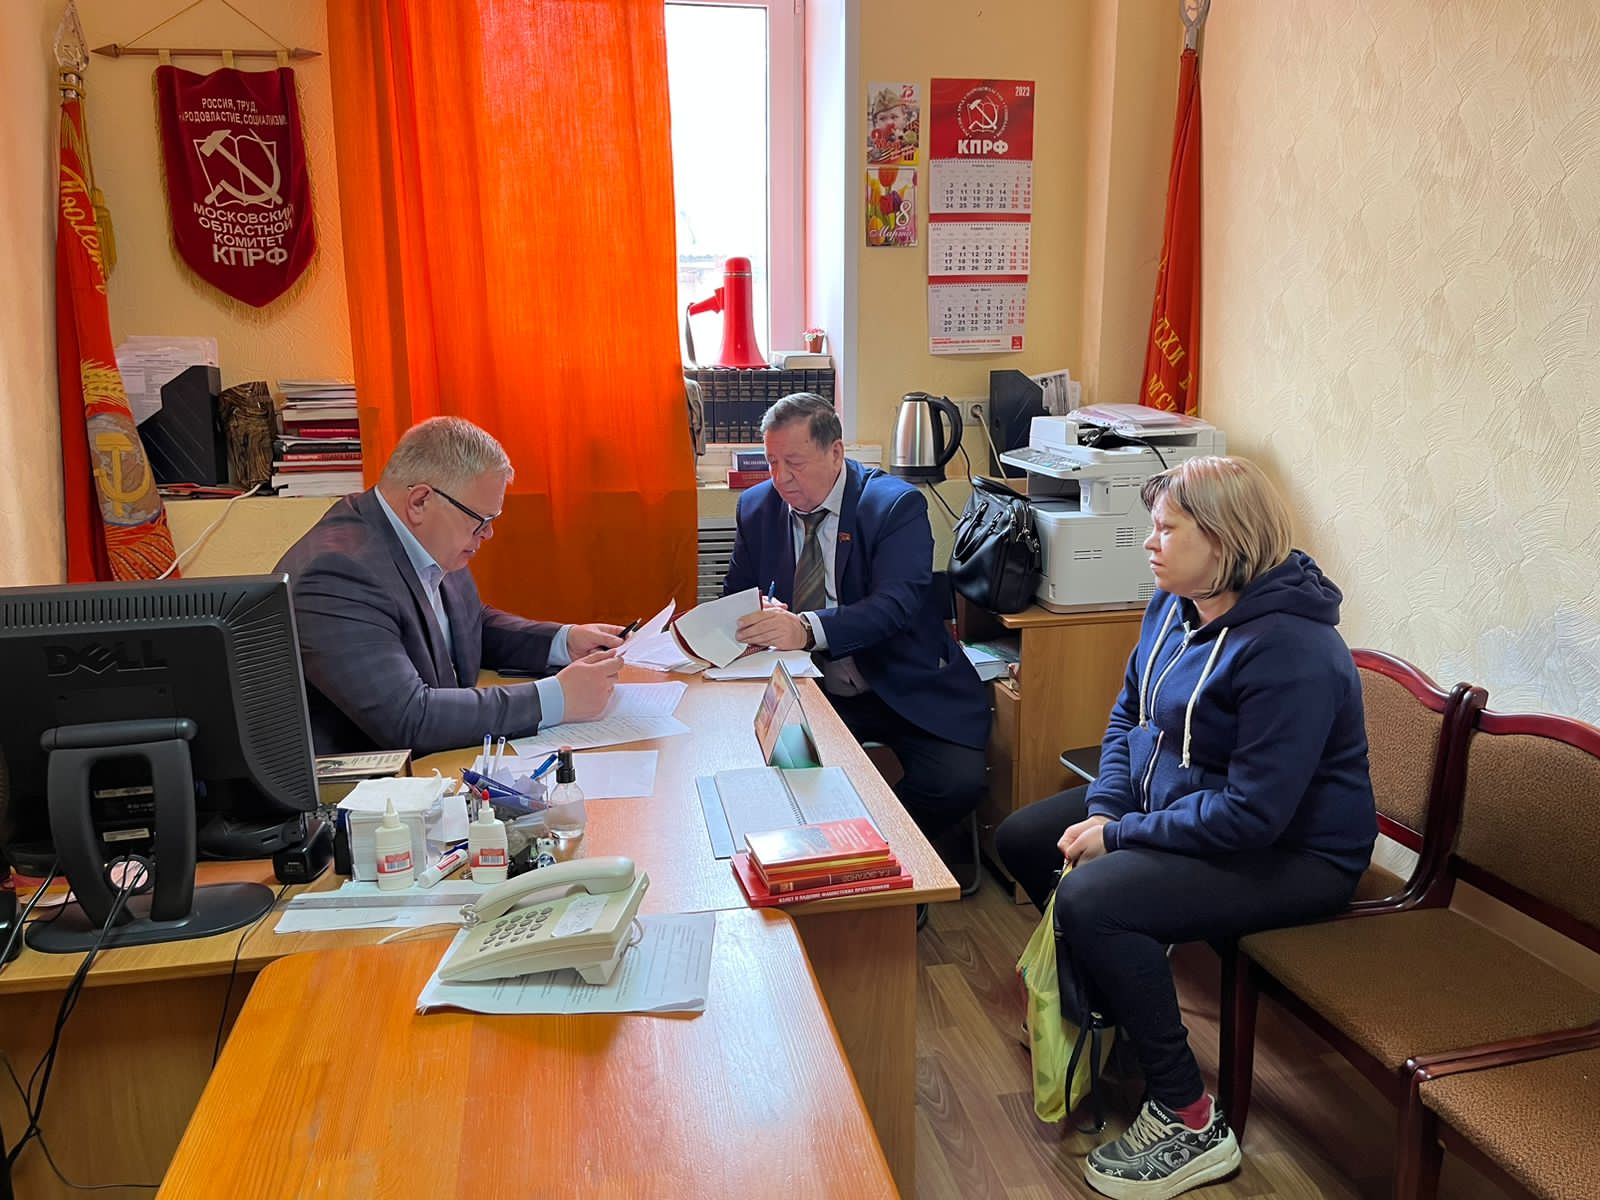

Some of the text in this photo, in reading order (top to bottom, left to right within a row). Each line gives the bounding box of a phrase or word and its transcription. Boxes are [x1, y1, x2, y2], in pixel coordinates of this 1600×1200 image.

[1015, 86, 1030, 97] 2023
[201, 98, 258, 113] РОССИЯ, ТРУД,
[957, 139, 1009, 155] КПРФ
[193, 202, 294, 224] МОСКОВСКИЙ
[896, 200, 911, 227] 8
[198, 217, 293, 236] ОБЛАСТНОЙ
[213, 232, 285, 248] КОМИТЕТ
[212, 243, 289, 267] КПРФ
[43, 639, 168, 677] DELL
